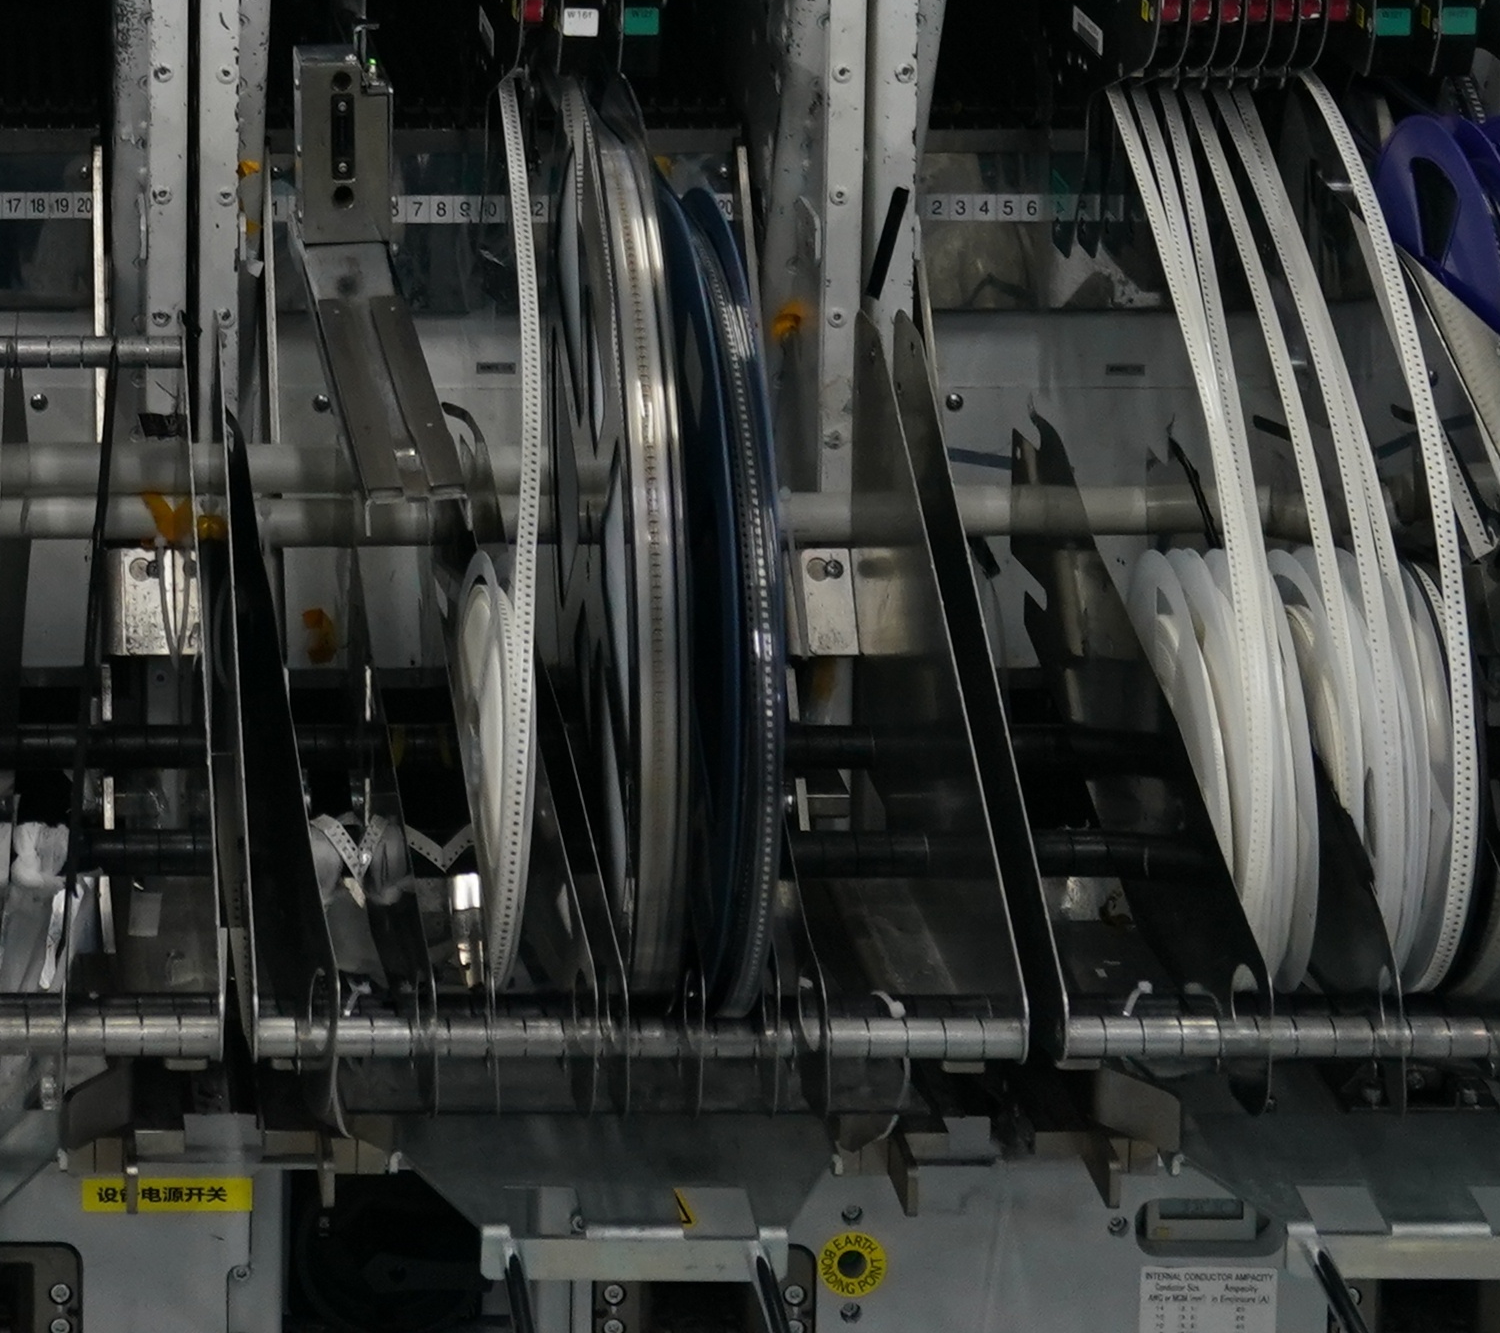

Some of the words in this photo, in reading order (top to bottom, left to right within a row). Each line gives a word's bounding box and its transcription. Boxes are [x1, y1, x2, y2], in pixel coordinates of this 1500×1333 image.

[5, 199, 22, 214] 17
[29, 199, 46, 214] 18
[54, 199, 70, 214] 19
[833, 1235, 878, 1254] EARTH
[821, 1249, 855, 1294] BONDING
[858, 1258, 882, 1292] POINT
